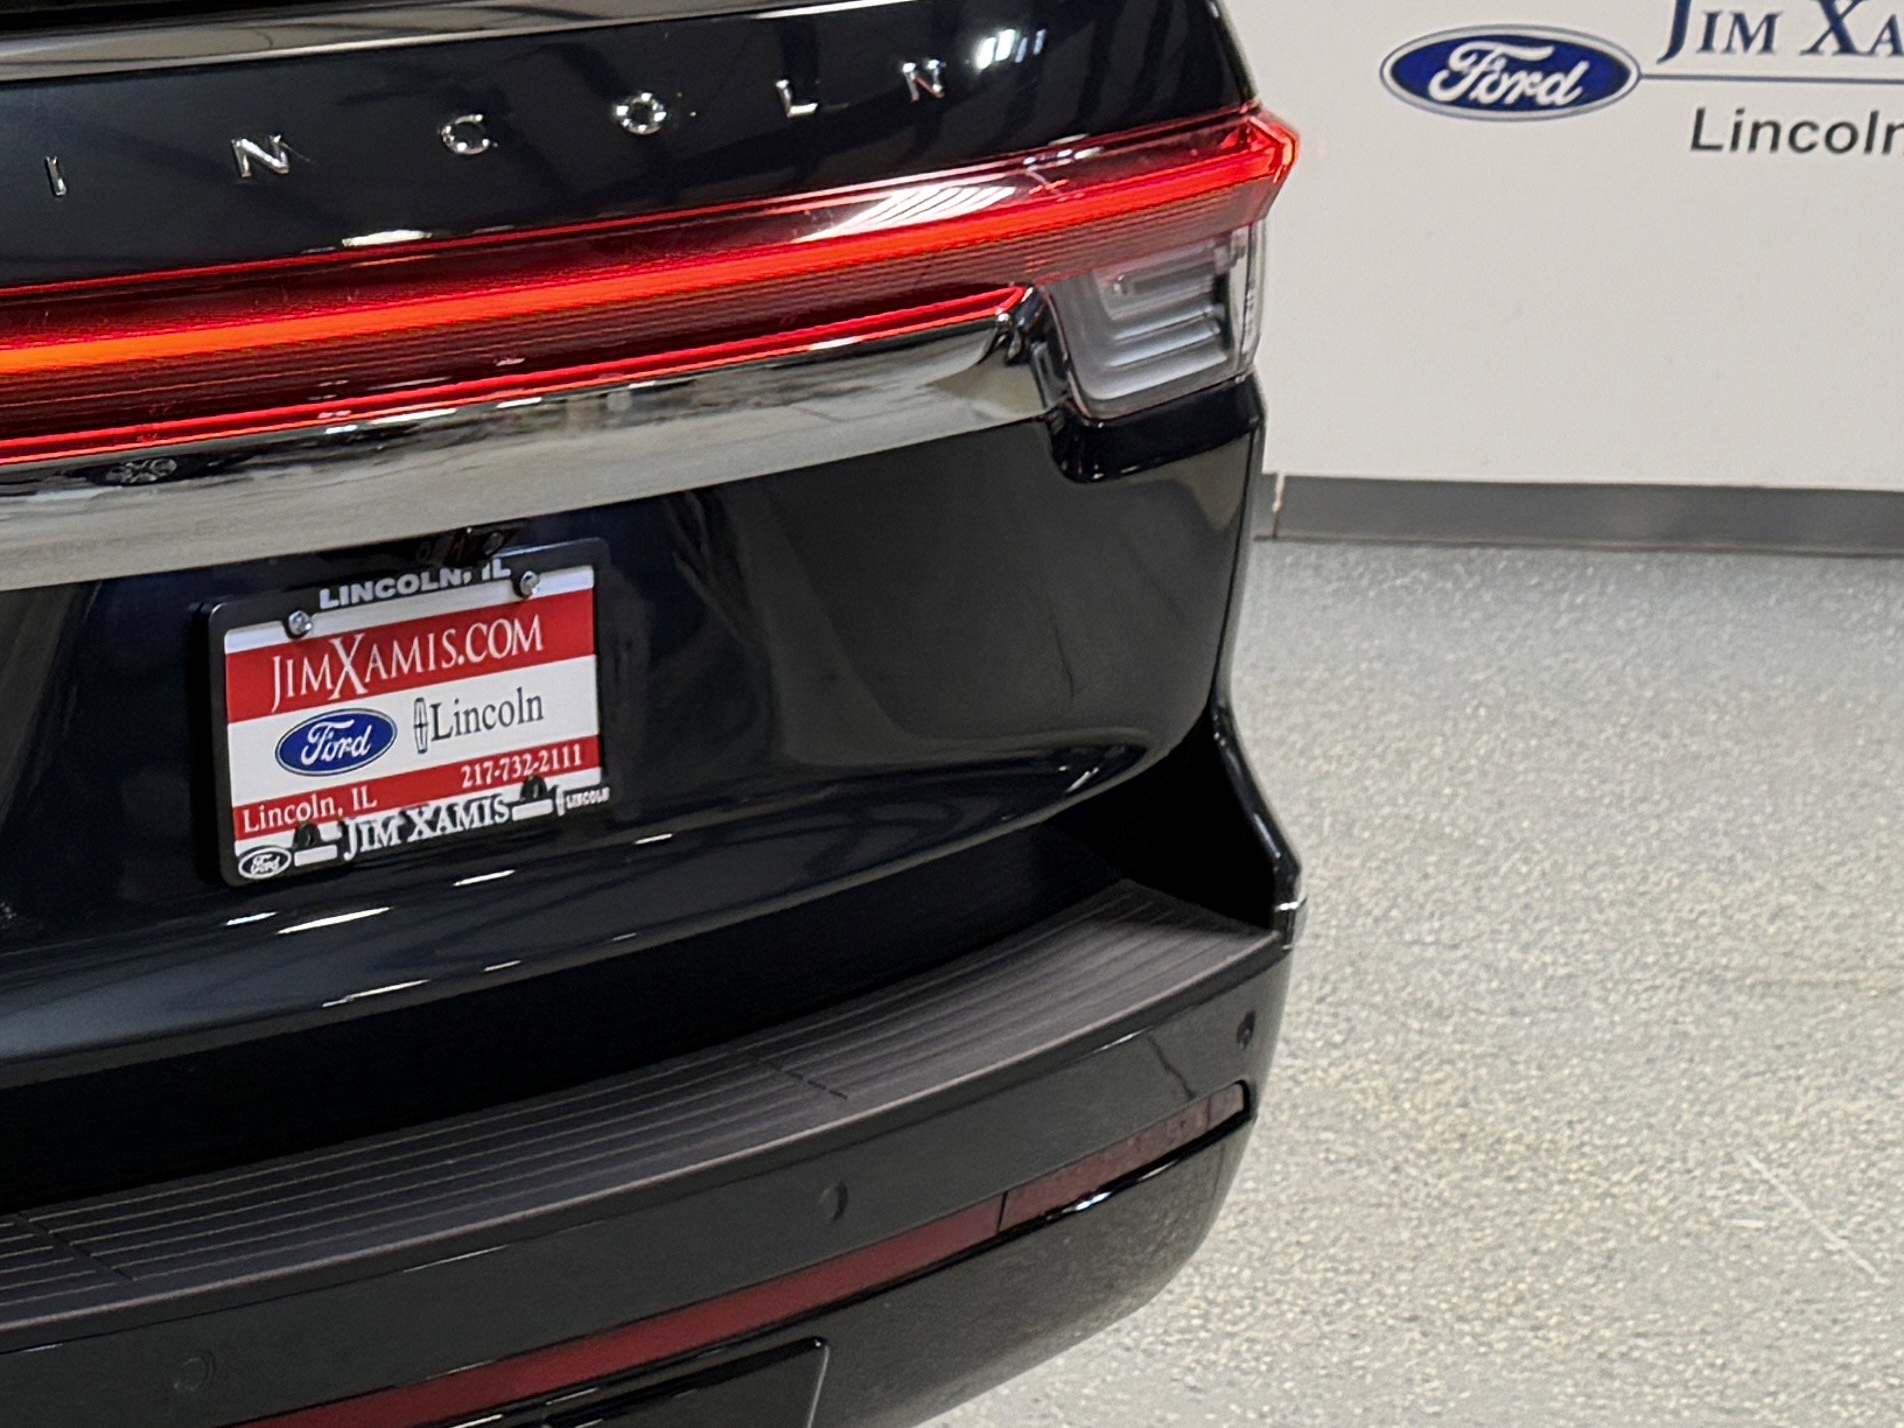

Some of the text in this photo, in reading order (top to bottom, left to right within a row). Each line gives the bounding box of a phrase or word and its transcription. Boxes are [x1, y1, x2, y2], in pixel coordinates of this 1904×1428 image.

[1427, 40, 1590, 107] Ford
[270, 614, 545, 714] JIMXAMIS.COM
[300, 718, 372, 766] Ford
[429, 686, 545, 742] Lincoln
[461, 743, 583, 789] 217-732-2111
[242, 785, 378, 833] Lincoln, IL
[343, 797, 511, 861] JIM XAMIS
